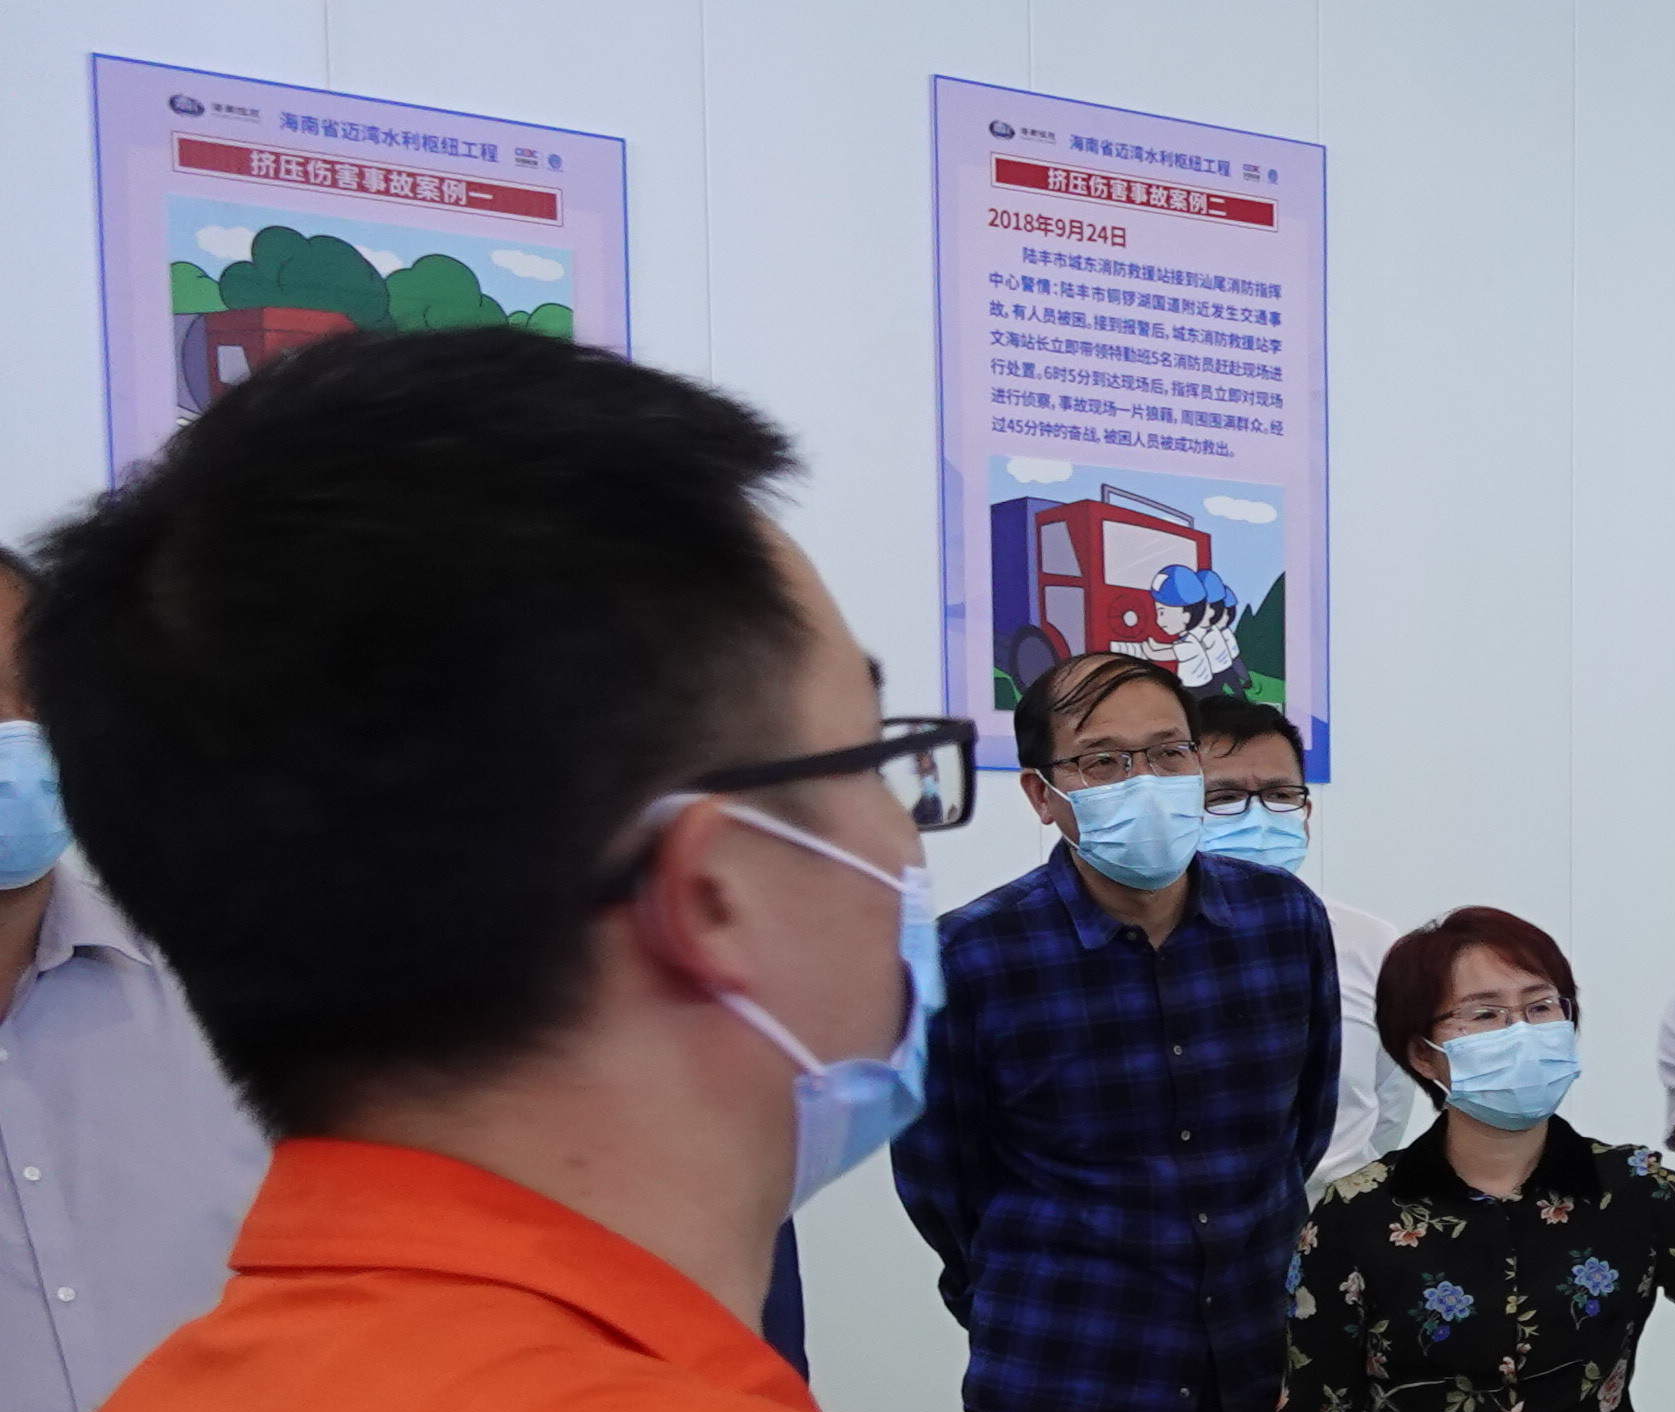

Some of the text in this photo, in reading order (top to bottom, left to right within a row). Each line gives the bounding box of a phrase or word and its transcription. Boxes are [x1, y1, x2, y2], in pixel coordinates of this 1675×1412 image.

[280, 112, 498, 163] 海南省迈湾水利枢纽工程
[1070, 134, 1231, 178] 海南省迈湾水利枢纽工程
[250, 150, 494, 204] 挤压伤害事故案例一
[1048, 168, 1226, 217] 挤压伤害事故案例二
[988, 208, 1127, 248] 2018年9月24日
